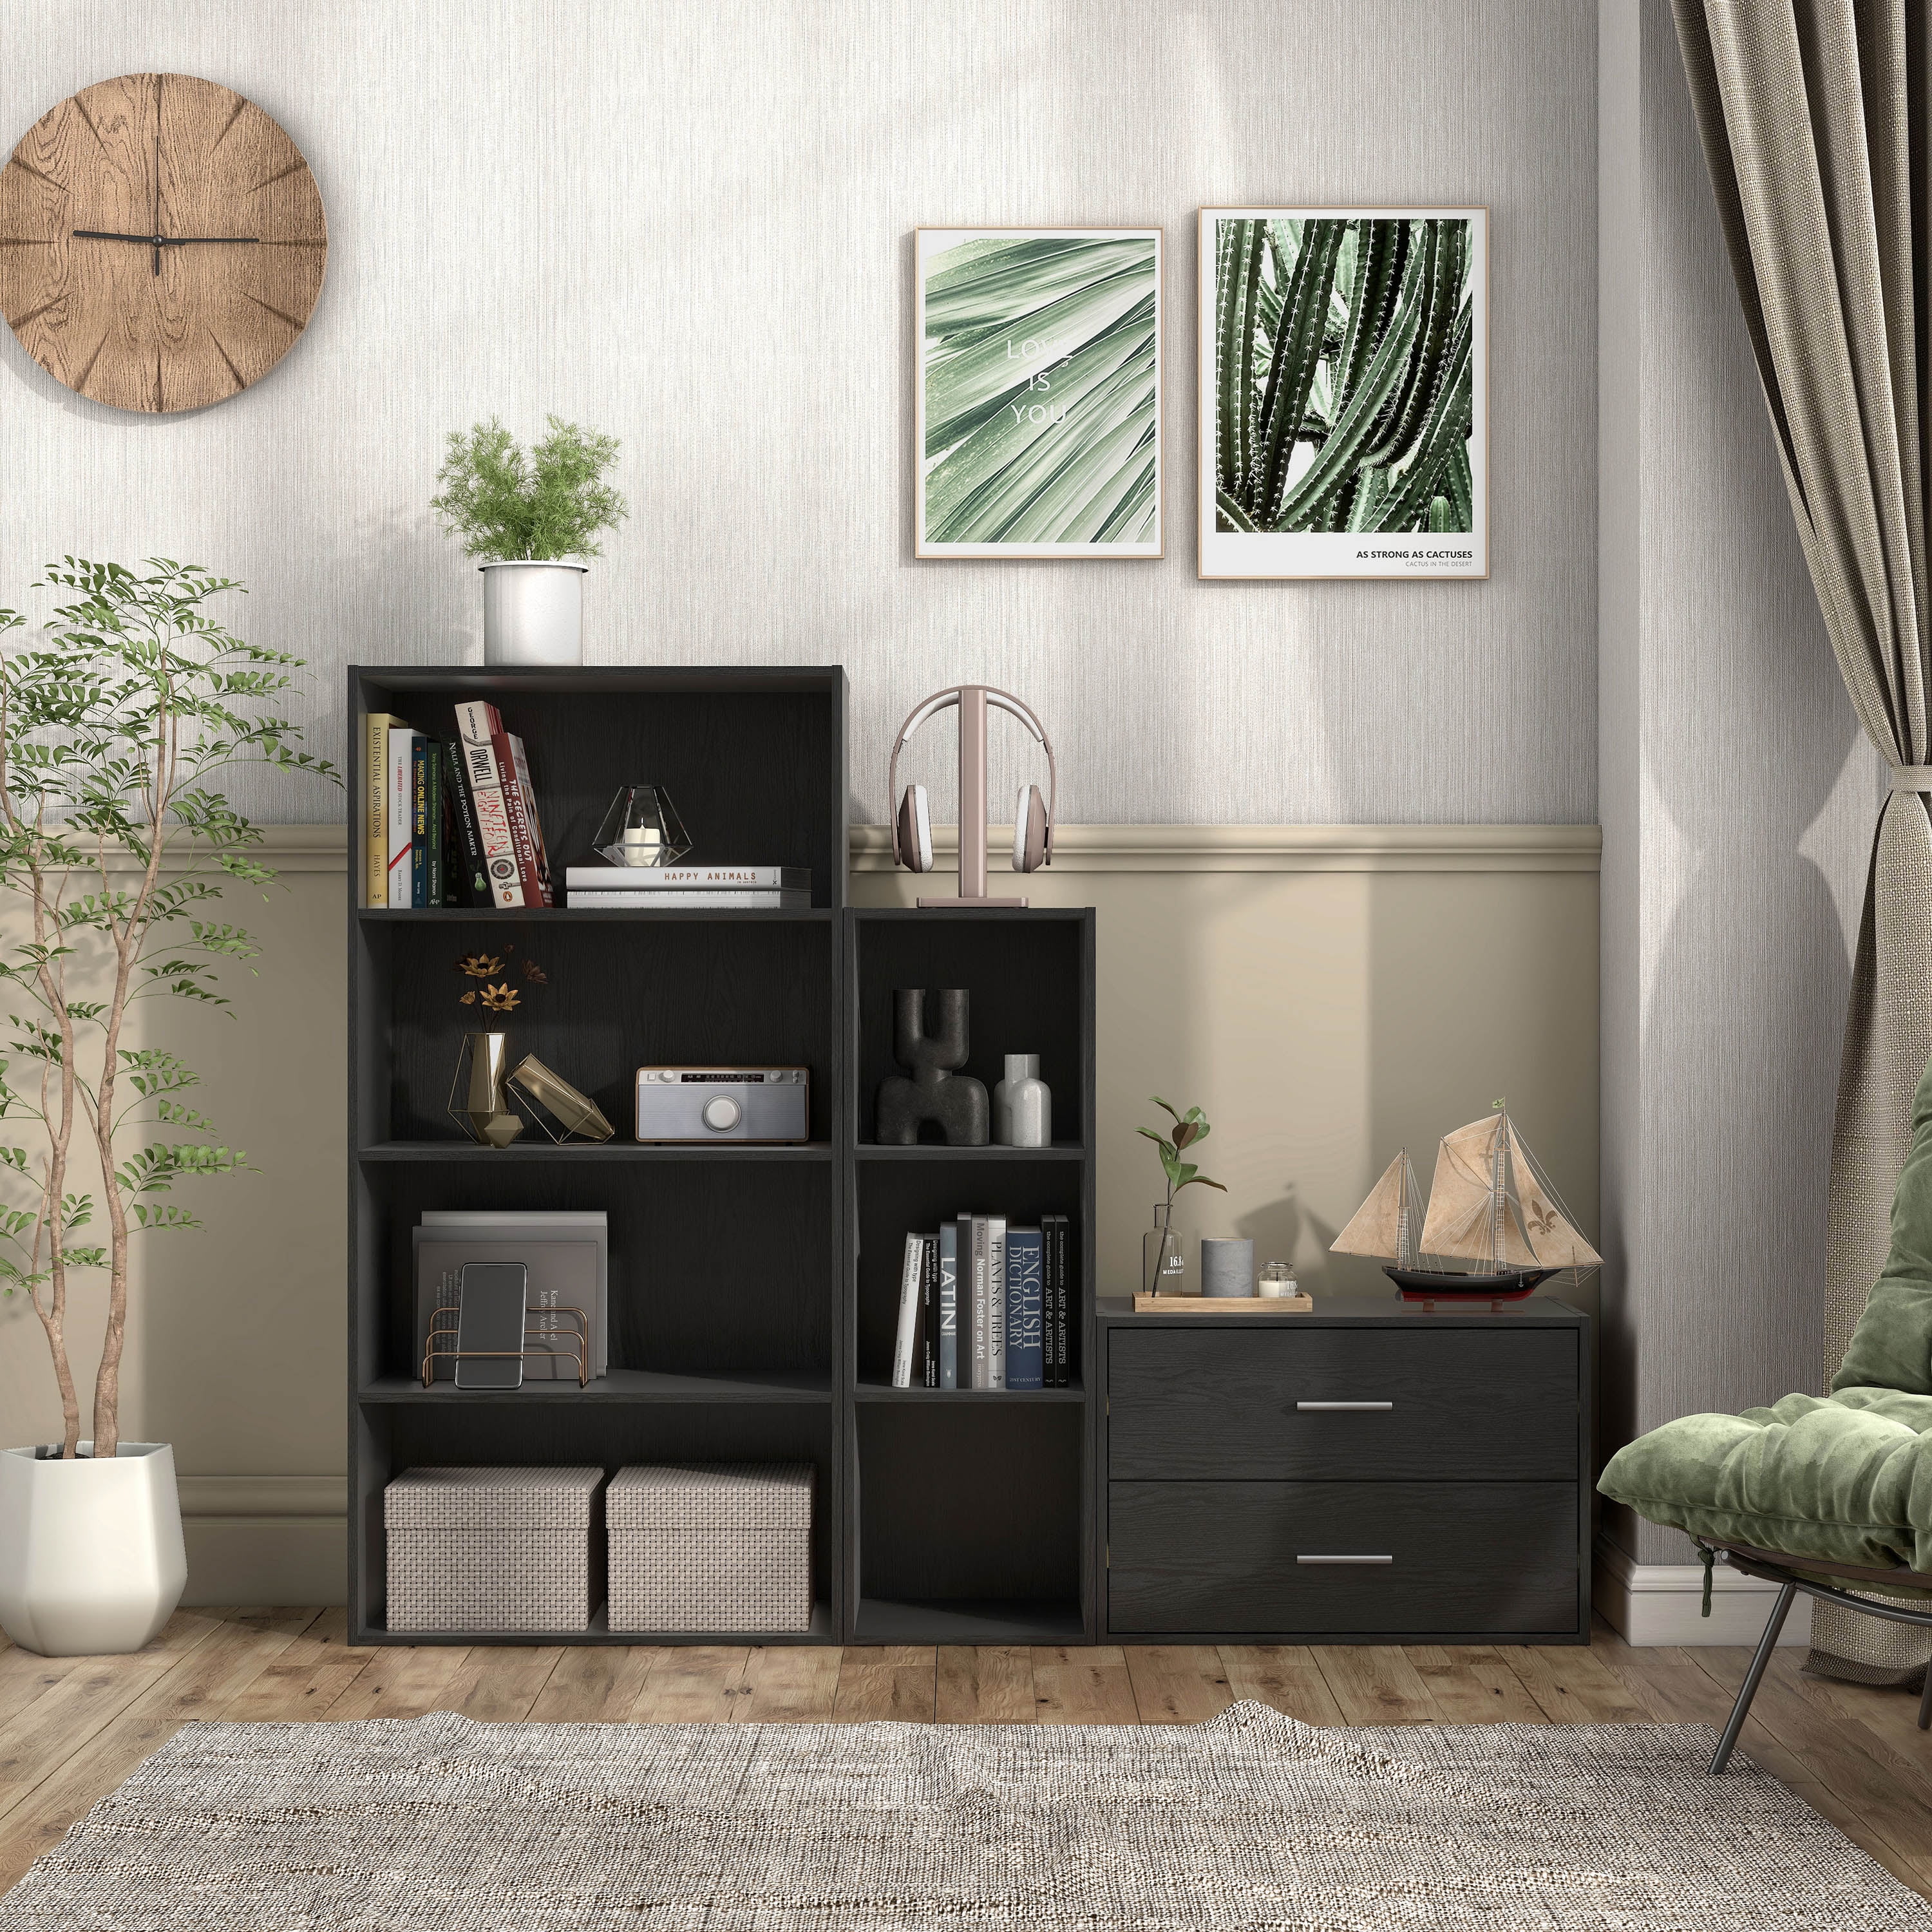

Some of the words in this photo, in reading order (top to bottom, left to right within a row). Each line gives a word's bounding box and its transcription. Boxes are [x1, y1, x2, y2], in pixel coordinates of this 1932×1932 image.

[1030, 372, 1050, 391] IS
[1010, 404, 1066, 424] YOU
[468, 707, 478, 740] GEORGE
[373, 726, 381, 781] EXISTENTIAL
[470, 749, 492, 783] ORWELL
[449, 742, 457, 767] NALIA
[461, 797, 471, 829] POTION
[467, 829, 477, 857] MAKER
[509, 779, 519, 797] THE
[372, 784, 381, 838] ASPIRATIONS
[486, 790, 509, 853] NINETEEN
[498, 762, 507, 782] Living
[512, 826, 524, 864] Conditional
[513, 800, 528, 841] SECRETS
[523, 844, 532, 862] OUT
[707, 872, 757, 880] ANIMALS
[975, 1223, 985, 1256] Moving
[976, 1258, 985, 1296] Norman
[991, 1242, 1002, 1296] PLANTS
[539, 1291, 548, 1314] Jeffry
[941, 1257, 956, 1329] LATIN
[991, 1298, 1002, 1307] &
[1009, 1246, 1023, 1350] DICTIONARY
[1023, 1245, 1041, 1349] ENGLISH
[976, 1298, 985, 1329] Foster
[1046, 1311, 1052, 1320] &
[1059, 1311, 1066, 1320] &
[976, 1331, 983, 1342] on
[991, 1312, 1002, 1356] TREES
[976, 1344, 985, 1359] Art
